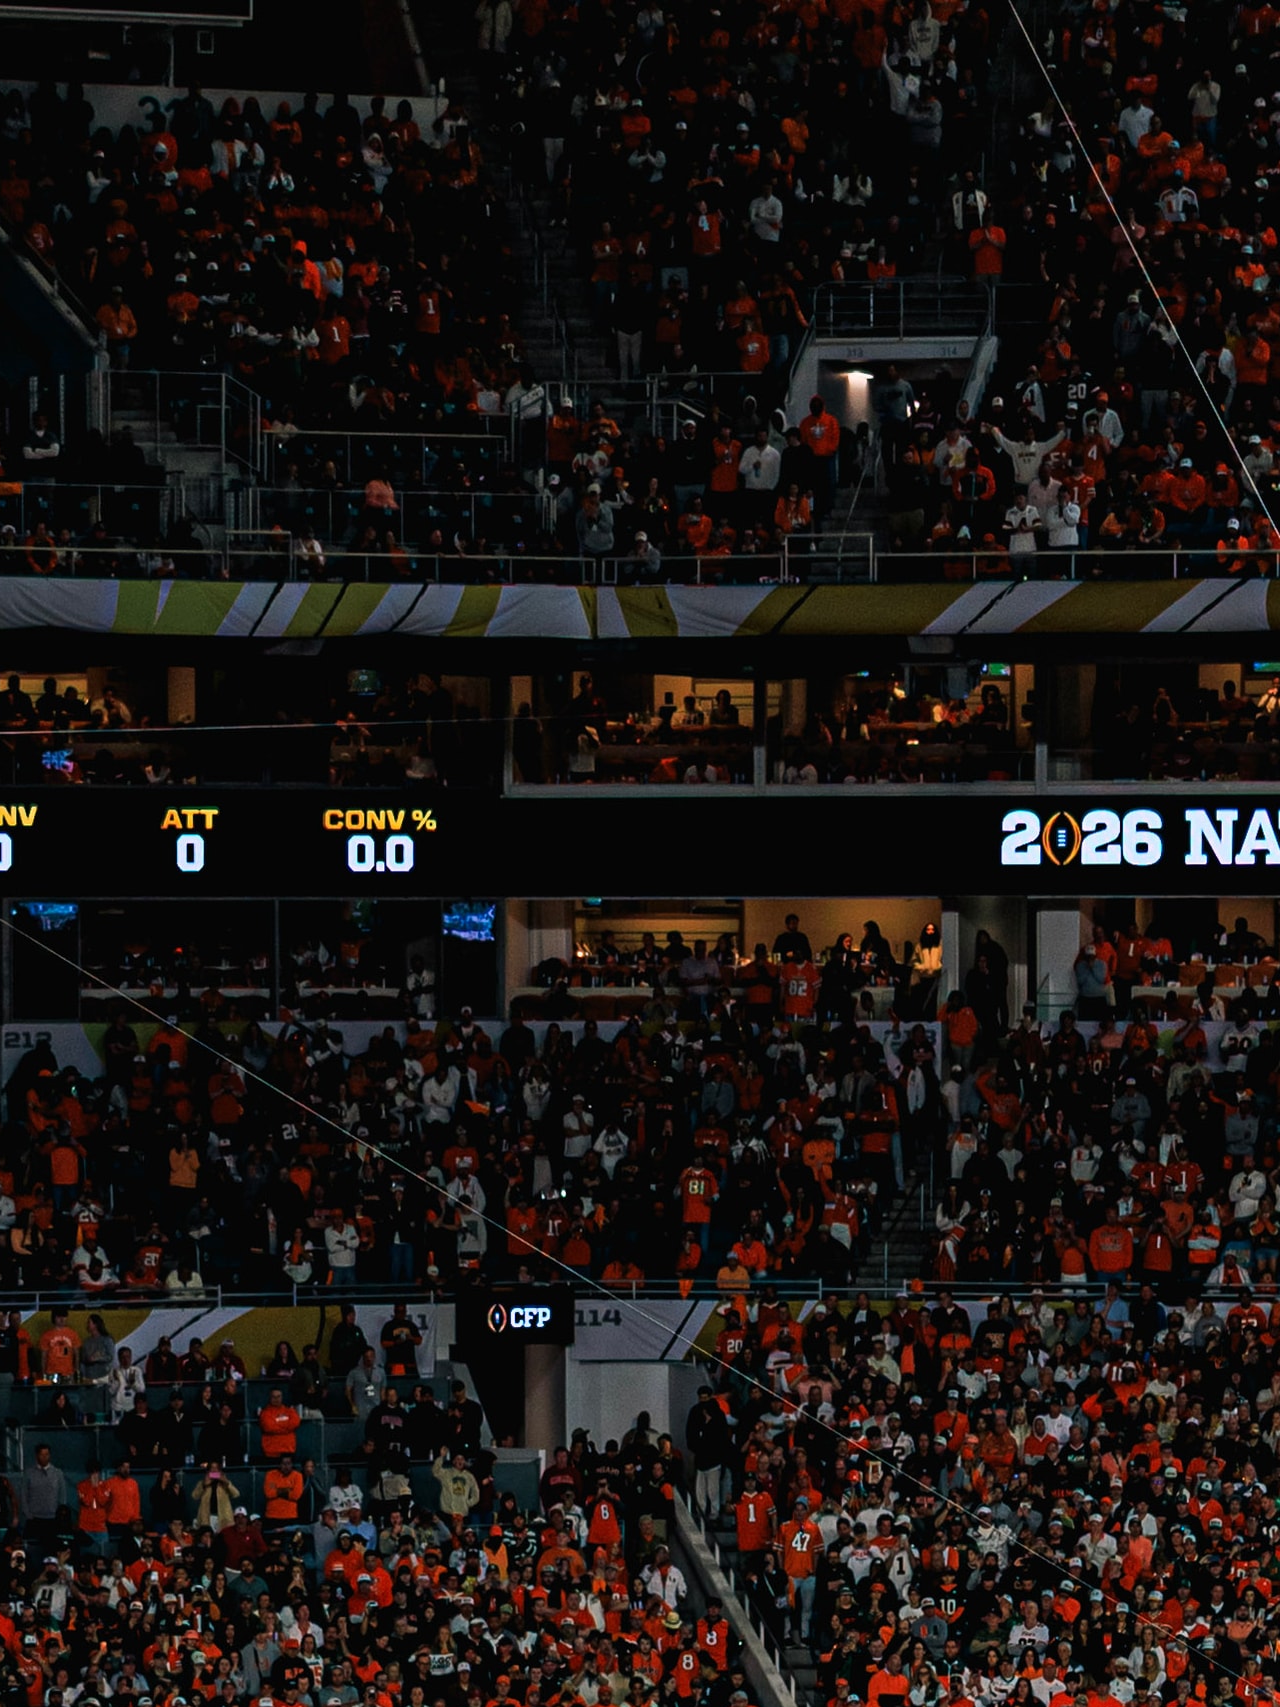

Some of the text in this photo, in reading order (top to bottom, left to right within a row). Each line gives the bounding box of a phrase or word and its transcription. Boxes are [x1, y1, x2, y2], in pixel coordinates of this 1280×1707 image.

[160, 808, 220, 831] ATT
[323, 809, 437, 831] CONV %
[176, 835, 204, 873] 0
[347, 835, 414, 872] 0.0
[510, 1307, 551, 1328] CFP
[574, 1307, 621, 1327] 114
[726, 1338, 743, 1353] 20
[747, 1502, 757, 1523] 1
[792, 1533, 810, 1551] 47
[895, 1556, 906, 1576] 1
[939, 1597, 958, 1615] 10
[704, 1630, 718, 1648] 8
[682, 1653, 695, 1671] 8
